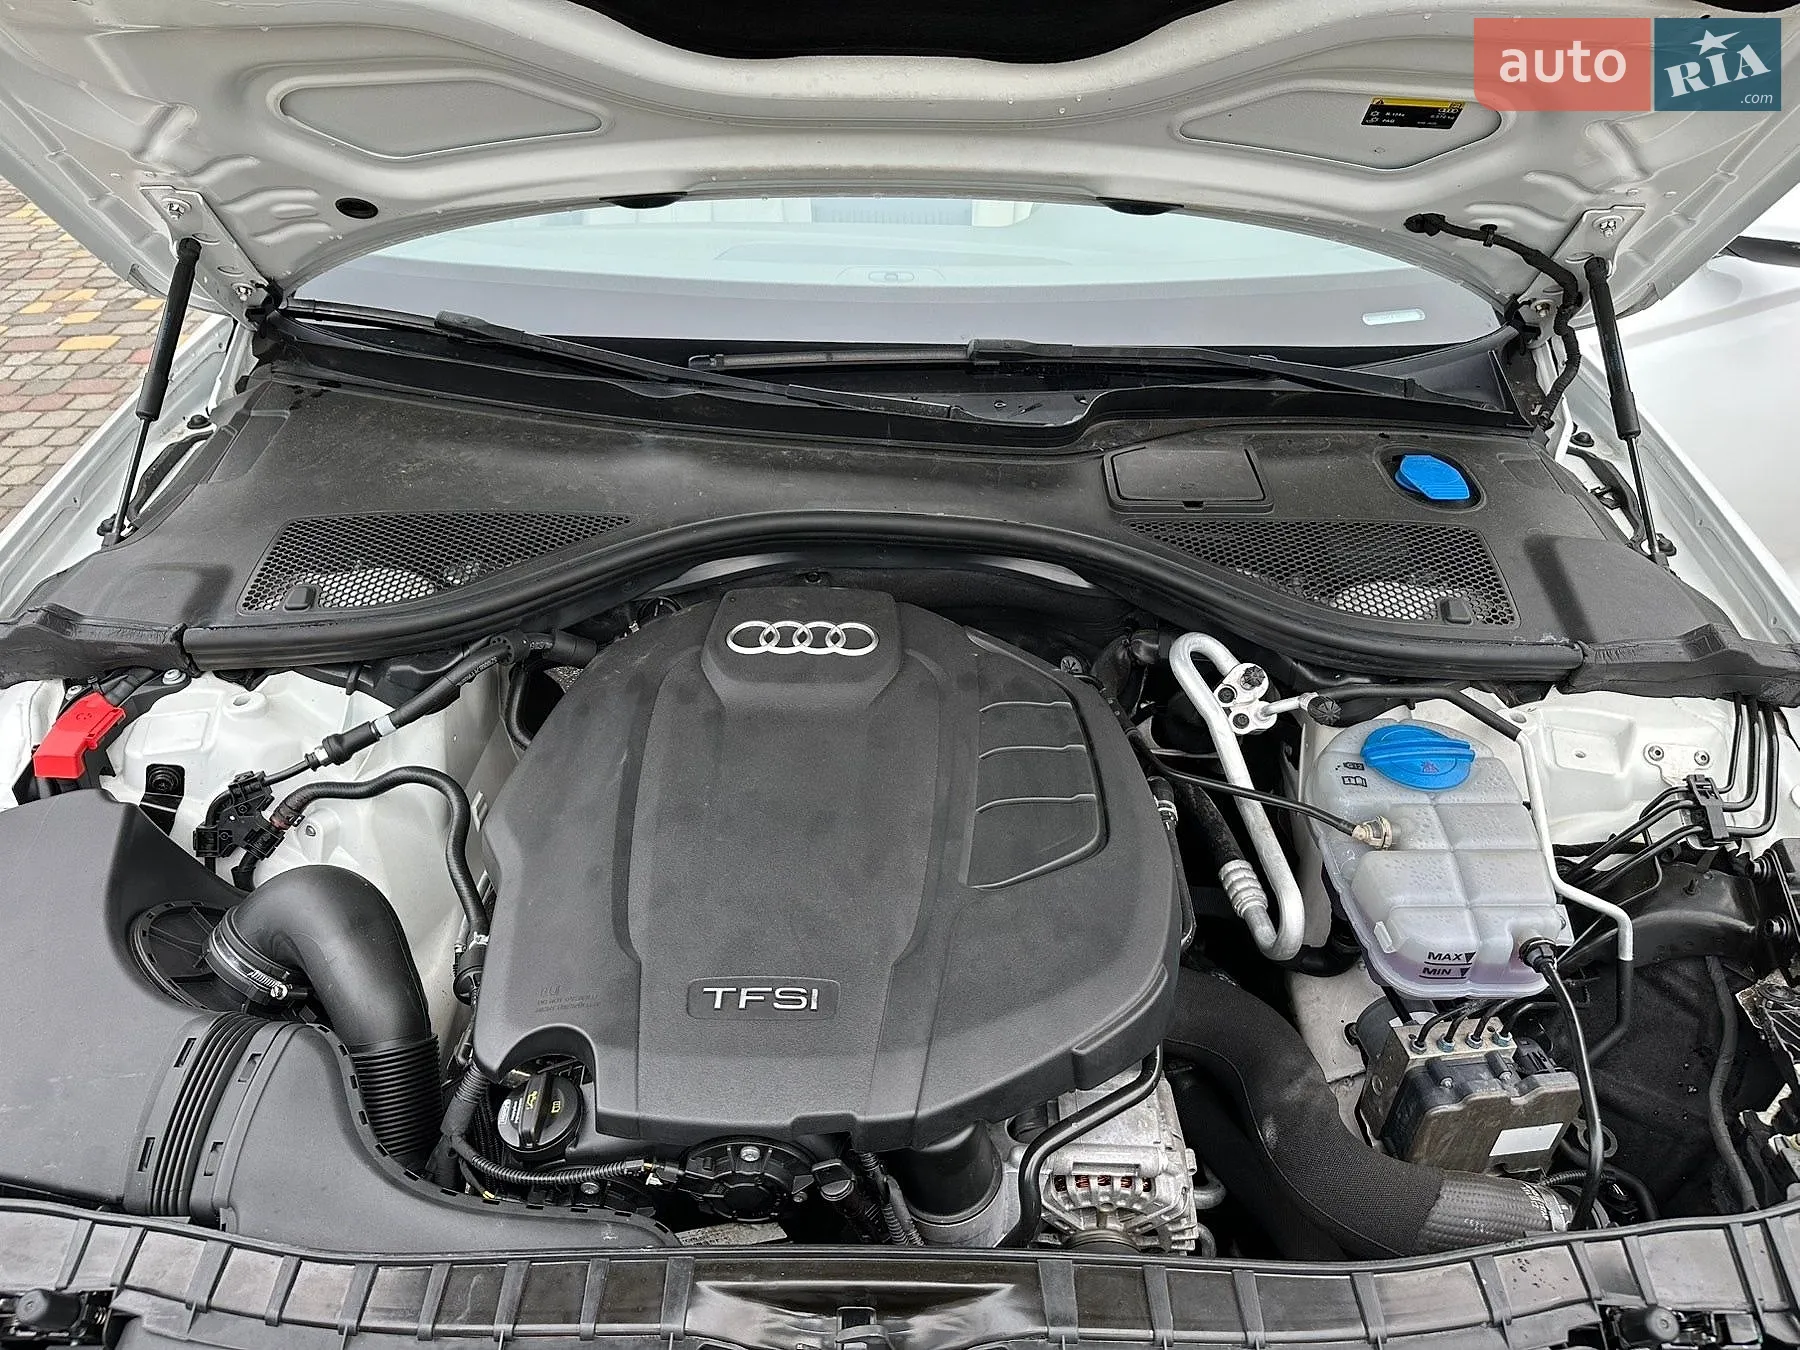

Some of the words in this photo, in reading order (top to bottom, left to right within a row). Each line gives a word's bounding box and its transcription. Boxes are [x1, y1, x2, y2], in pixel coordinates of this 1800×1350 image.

[1427, 951, 1463, 961] MAX
[1422, 967, 1452, 975] MIN
[703, 987, 819, 1010] TFSI
